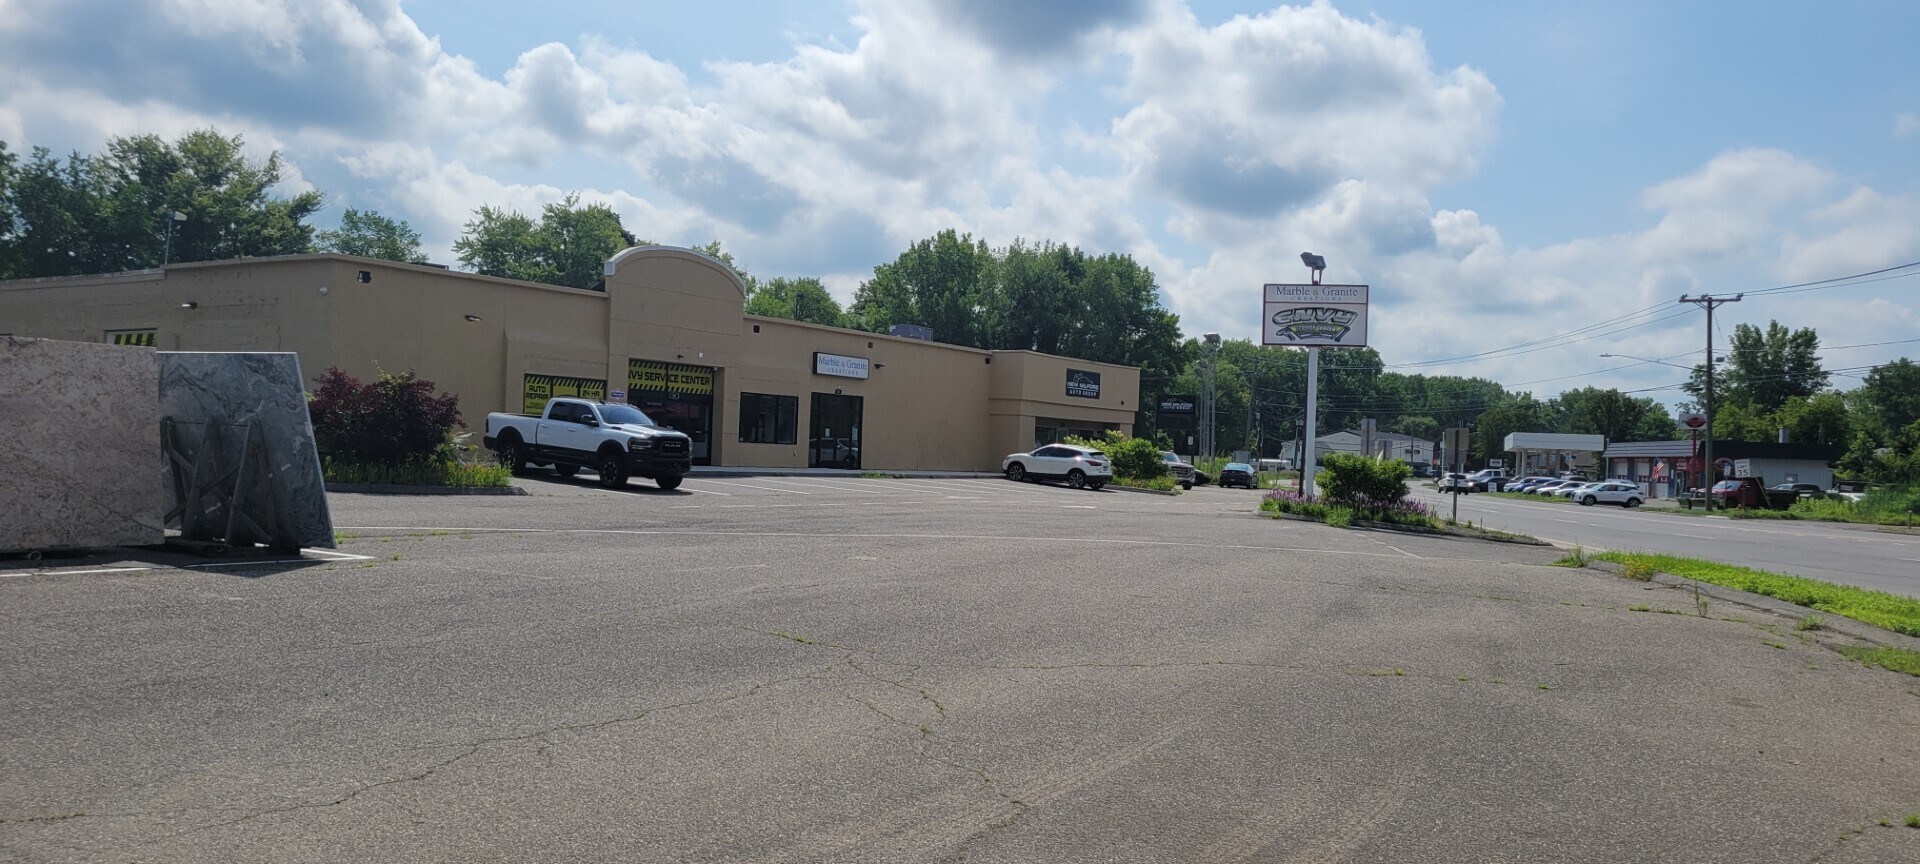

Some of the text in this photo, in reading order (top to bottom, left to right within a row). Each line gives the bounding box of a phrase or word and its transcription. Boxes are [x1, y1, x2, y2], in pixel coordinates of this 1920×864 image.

[1276, 286, 1310, 296] Marble
[1322, 287, 1358, 296] Granite
[818, 356, 840, 367] Marble
[846, 360, 868, 371] Granite
[680, 374, 710, 386] CENTER
[528, 385, 546, 393] AUTO
[582, 389, 590, 397] 24
[526, 392, 549, 400] REPAIR
[1737, 469, 1749, 477] 35
